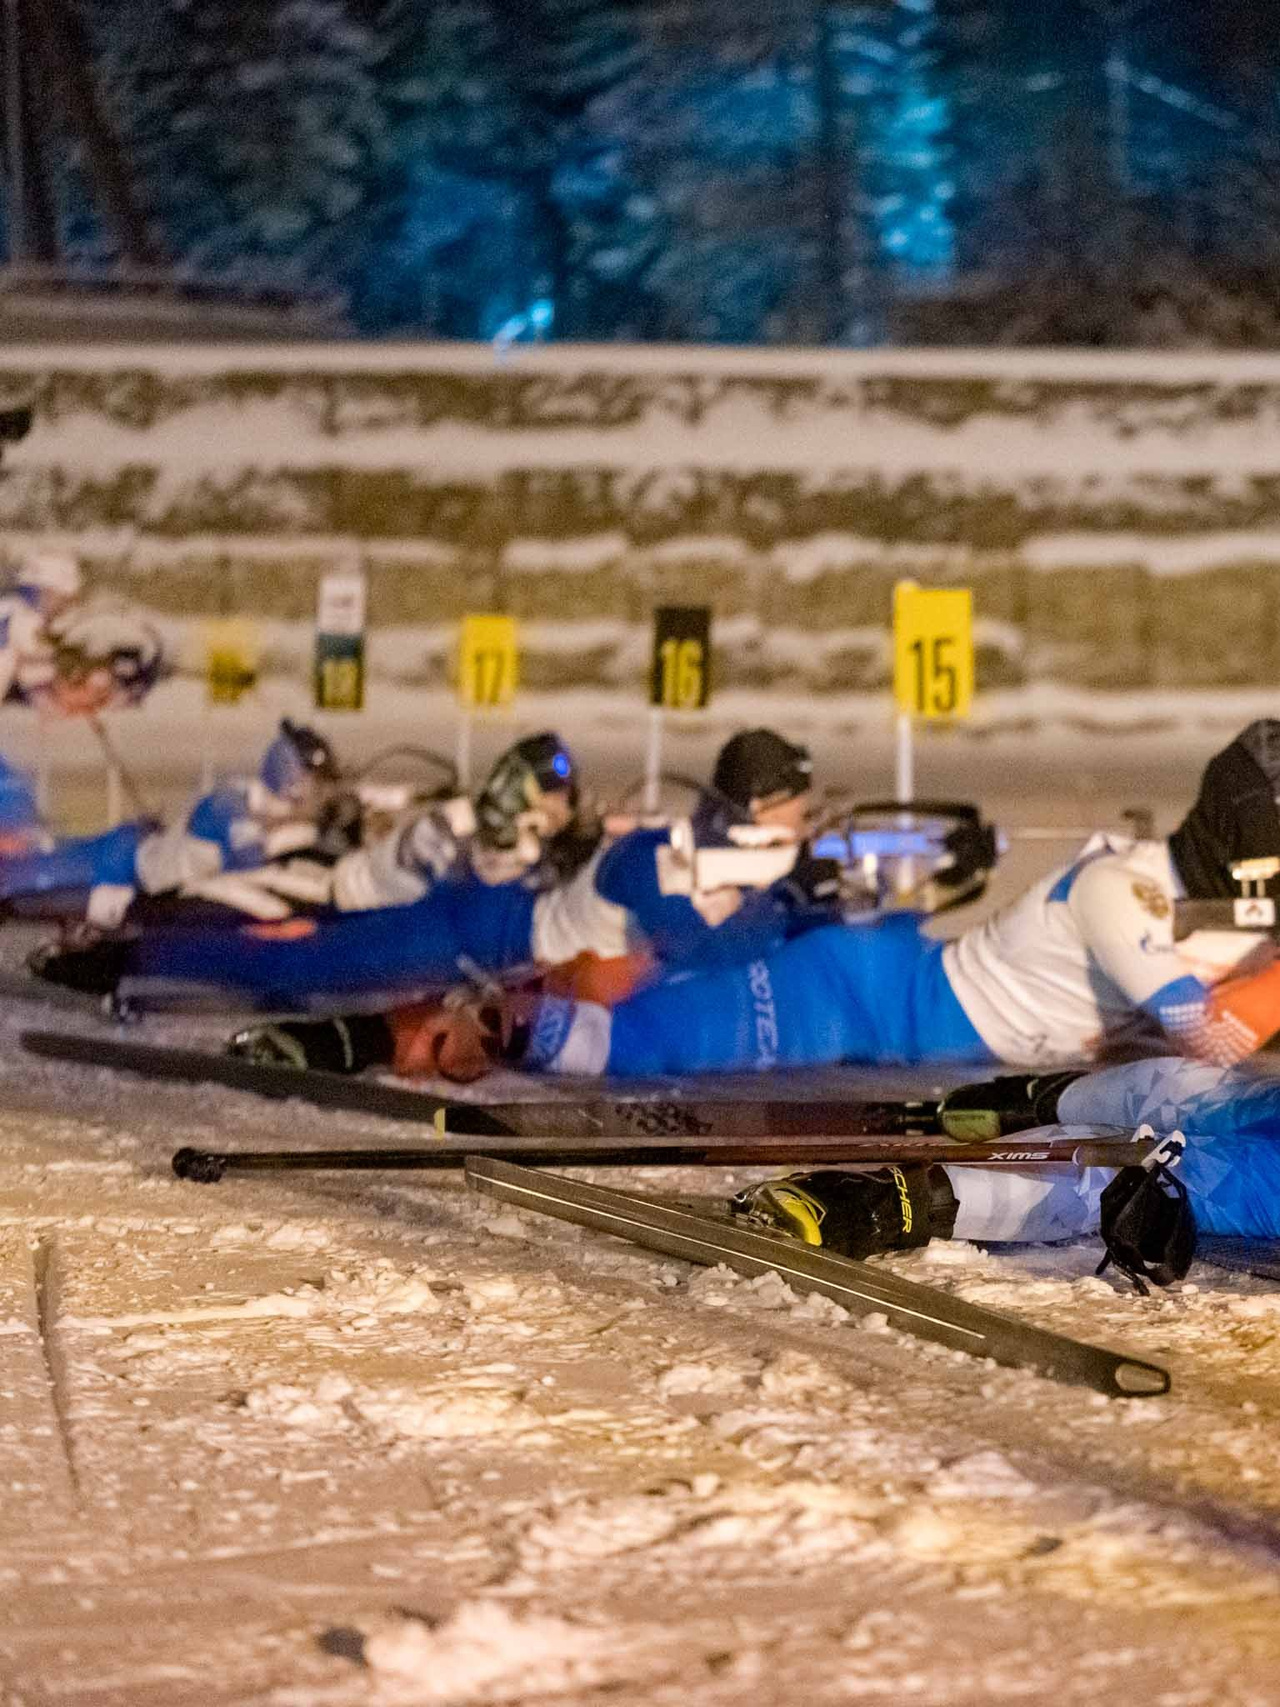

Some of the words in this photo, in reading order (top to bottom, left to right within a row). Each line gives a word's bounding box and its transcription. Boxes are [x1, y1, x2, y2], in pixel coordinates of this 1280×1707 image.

[473, 652, 506, 706] 17
[660, 639, 703, 708] 16
[909, 637, 956, 715] 15
